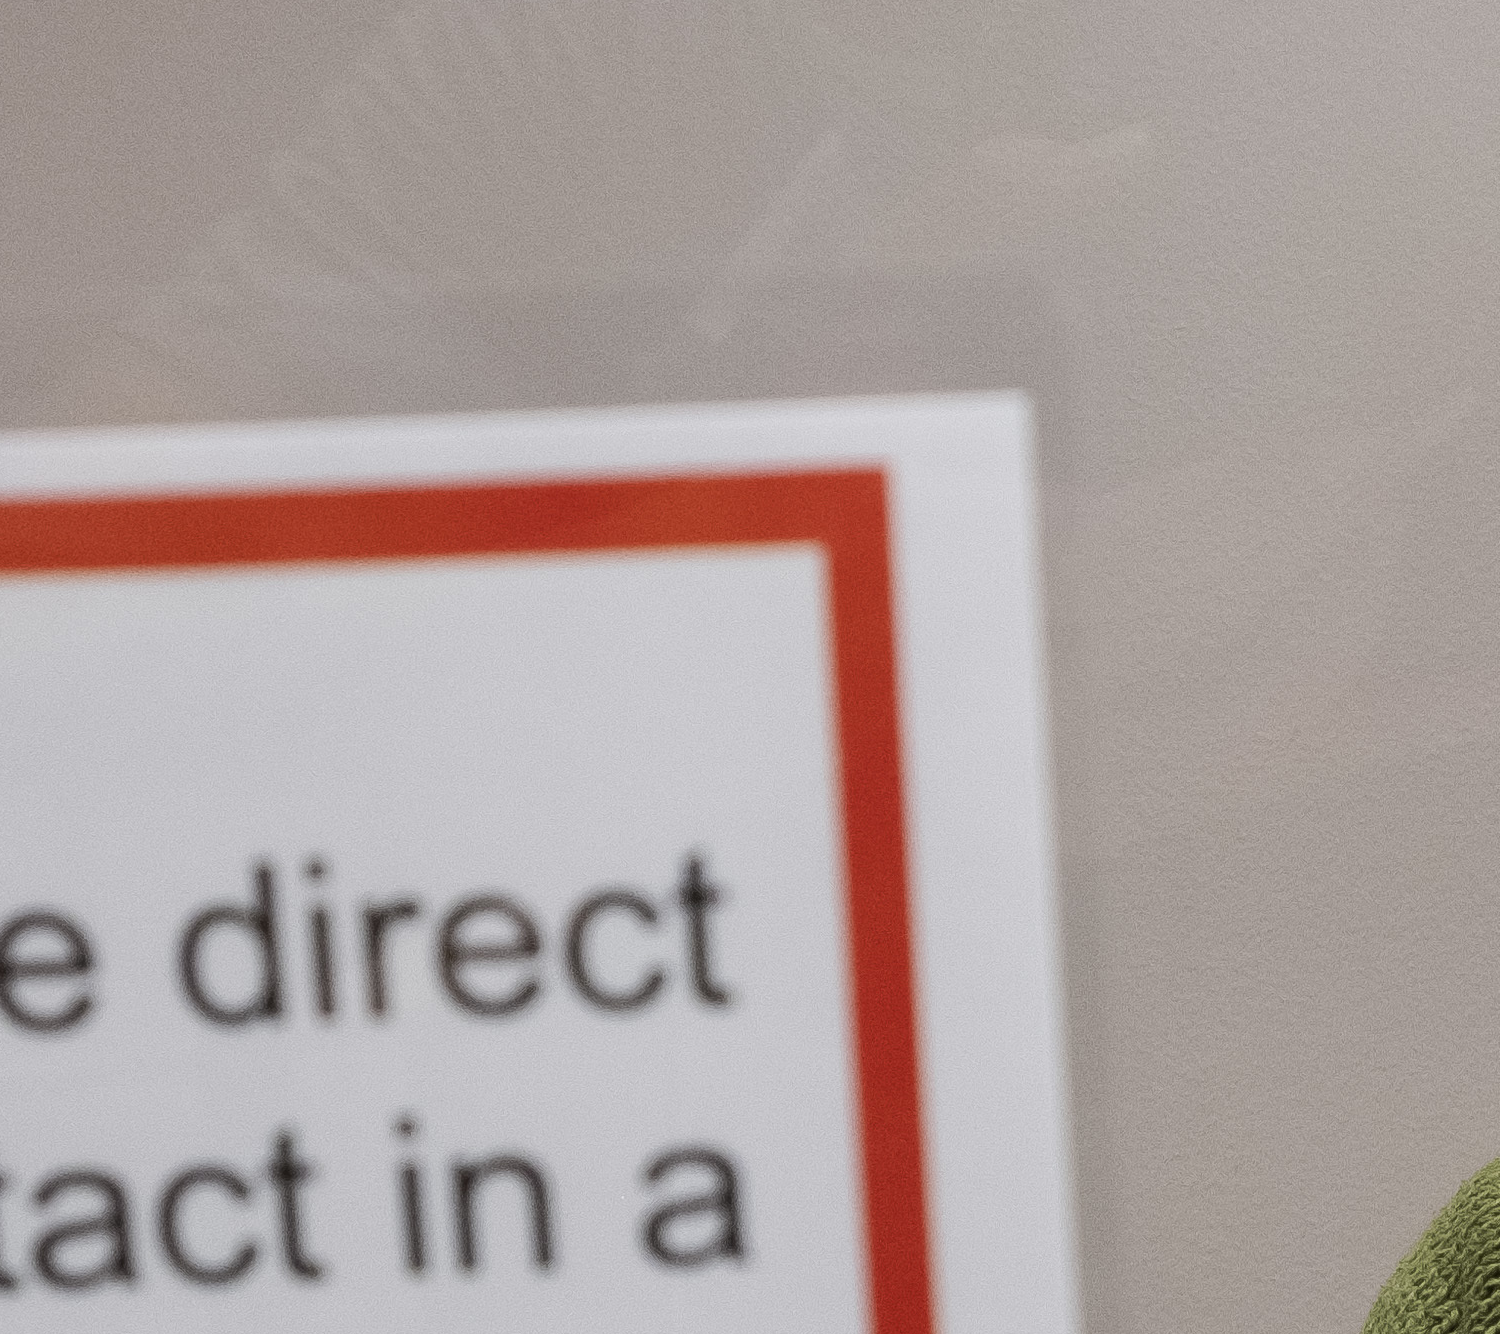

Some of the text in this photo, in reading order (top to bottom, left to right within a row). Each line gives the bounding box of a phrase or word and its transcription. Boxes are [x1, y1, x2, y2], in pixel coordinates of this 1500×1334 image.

[176, 854, 730, 1028] direct
[397, 1117, 556, 1274] in
[640, 1145, 750, 1271] a
